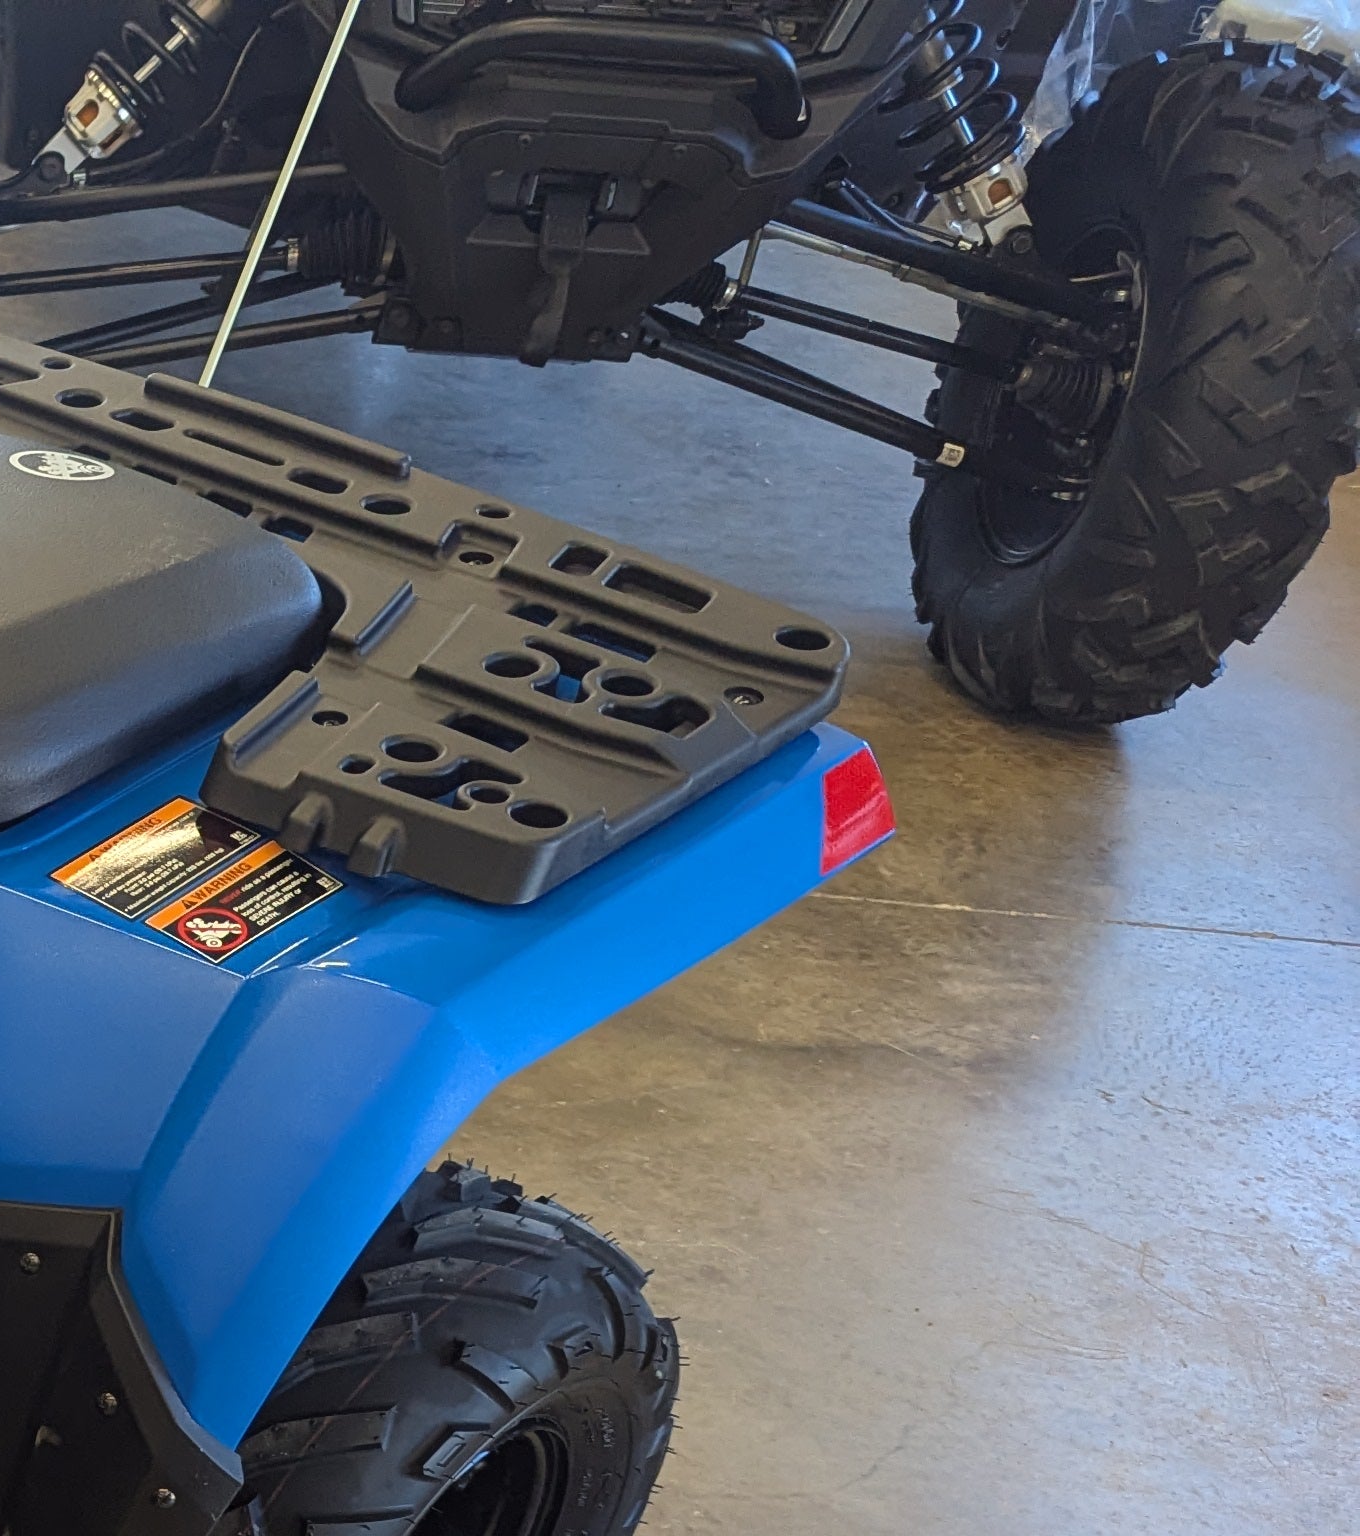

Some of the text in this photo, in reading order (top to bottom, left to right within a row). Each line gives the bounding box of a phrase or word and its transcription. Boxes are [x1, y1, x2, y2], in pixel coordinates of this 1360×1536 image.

[194, 863, 252, 899] WARNING
[233, 891, 267, 912] Passengers
[265, 884, 278, 892] can
